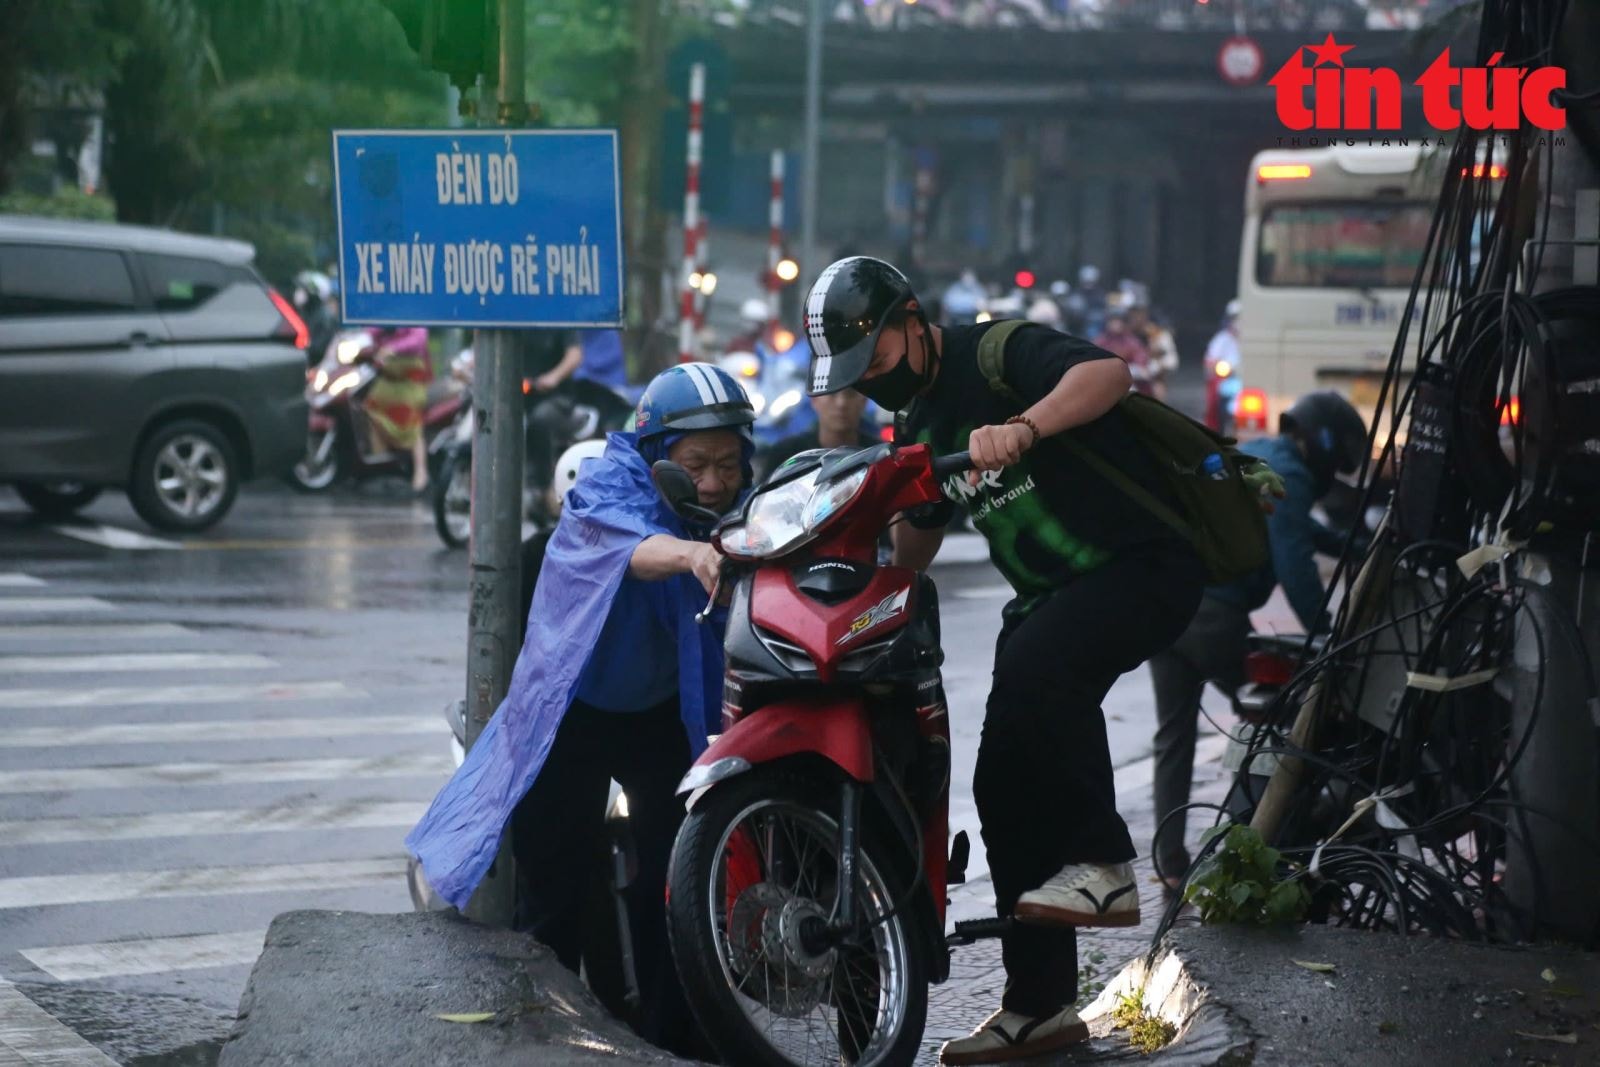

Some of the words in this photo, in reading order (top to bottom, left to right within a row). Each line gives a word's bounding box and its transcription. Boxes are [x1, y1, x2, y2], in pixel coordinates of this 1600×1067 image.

[436, 141, 483, 205] ĐÈN
[488, 134, 519, 205] ĐỎ
[355, 243, 385, 294] XE
[388, 232, 436, 294] MÁY
[444, 238, 504, 306] ĐƯỢC
[510, 235, 540, 295] RẼ
[546, 226, 600, 295] PHẢI
[990, 474, 1035, 509] brand
[808, 562, 856, 573] HONDA
